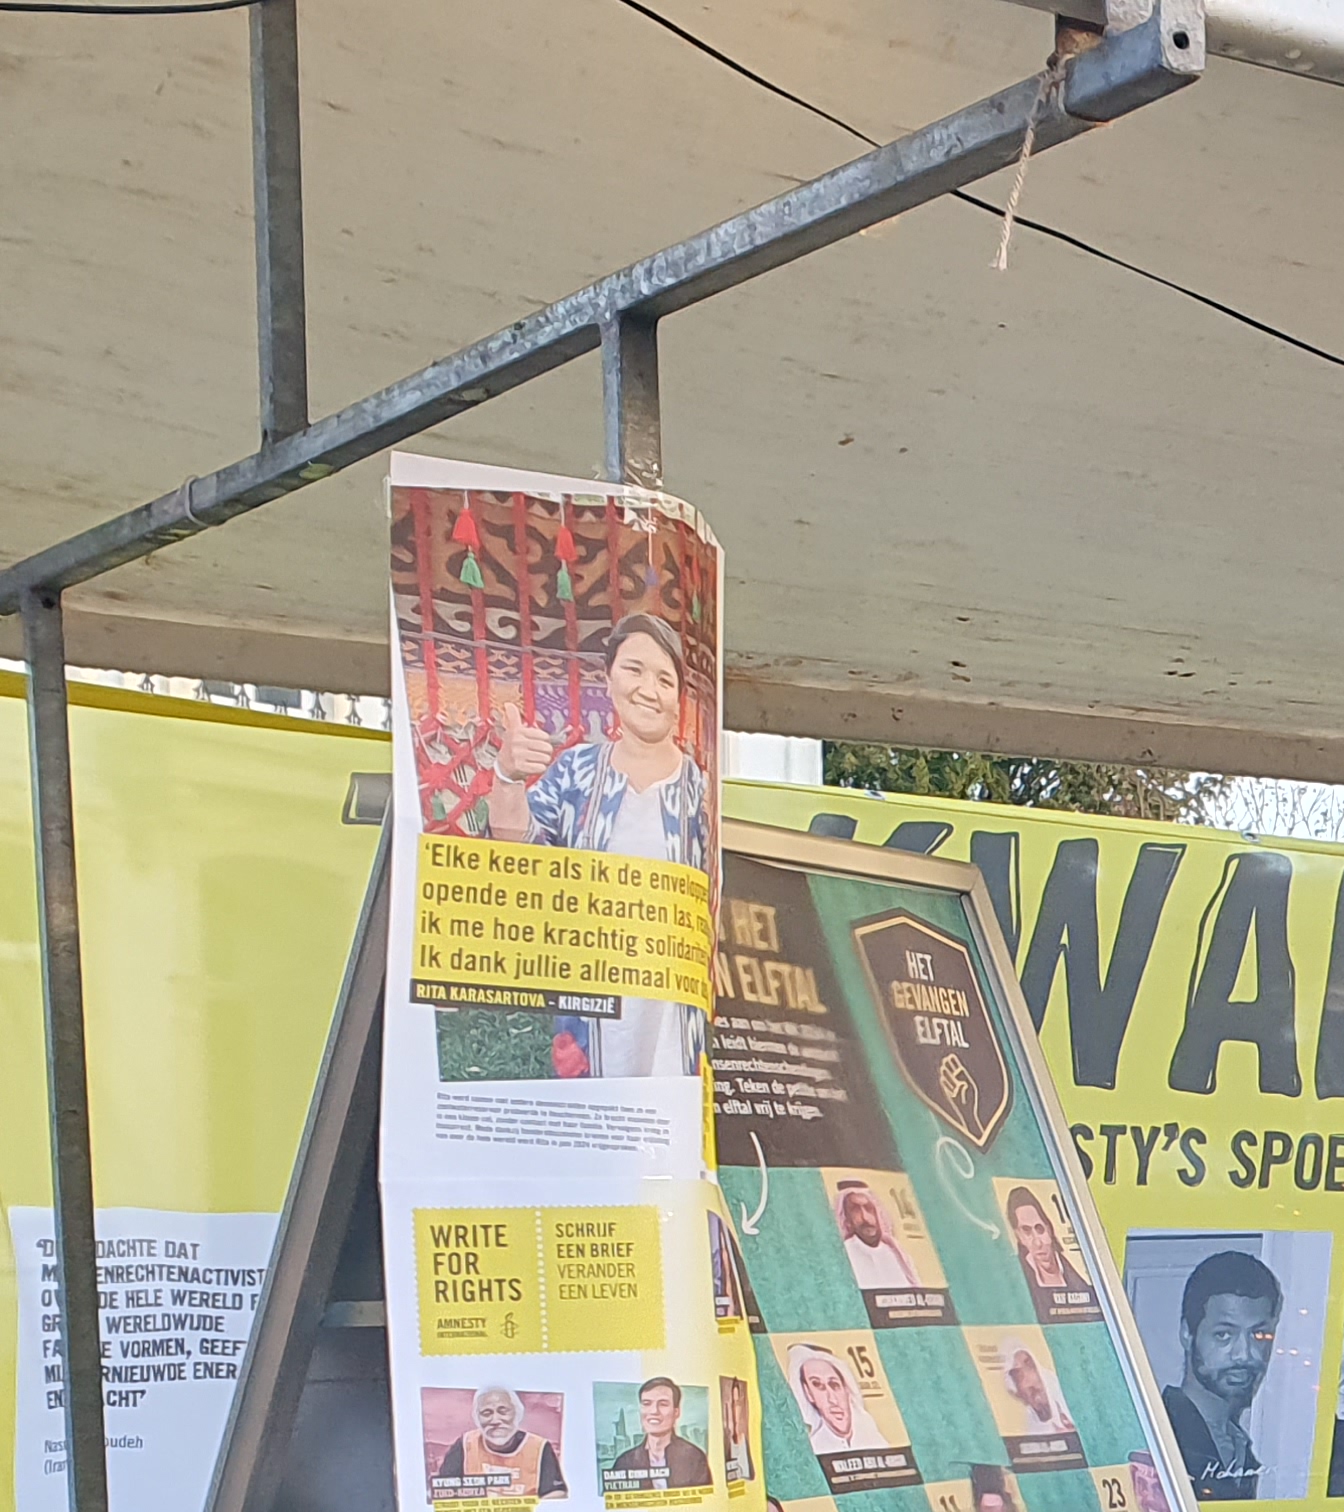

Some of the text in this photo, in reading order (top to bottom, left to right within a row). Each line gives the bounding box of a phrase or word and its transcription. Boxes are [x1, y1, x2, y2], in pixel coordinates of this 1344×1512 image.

[489, 849, 543, 876] keer
[549, 856, 581, 880] als
[590, 859, 609, 883] ik
[618, 863, 642, 886] de
[422, 881, 507, 907] opende
[516, 890, 543, 909] en
[552, 889, 578, 913] de
[587, 893, 668, 924] kaarten
[420, 911, 441, 935] ik
[450, 918, 484, 937] me
[493, 916, 534, 942] hoe
[544, 922, 638, 957] krachtig
[420, 945, 441, 968] Ik
[450, 947, 506, 974] dank
[514, 955, 571, 980] jullie
[580, 962, 670, 989] allemaal
[905, 950, 936, 982] HET
[416, 984, 447, 1000] RITA
[449, 986, 546, 1008] KARASARTOVA
[890, 981, 969, 1018] GEVANGEN
[913, 1015, 970, 1049] ELFTAL
[1072, 1122, 1207, 1187] STY'S
[430, 1224, 508, 1249] WRITE
[556, 1222, 617, 1239] SCHRIJF
[164, 1240, 200, 1261] DAT
[556, 1243, 634, 1259] EEN BRIEF
[433, 1252, 480, 1276] FOR
[557, 1263, 636, 1279] VERANDER
[125, 1289, 163, 1309] HELE
[171, 1289, 243, 1311] WERELD
[435, 1279, 522, 1303] RIGHTS
[559, 1283, 638, 1300] EEN LEVEN
[437, 1318, 486, 1330] AMNESTY
[120, 1338, 192, 1359] VORMEN,
[847, 1345, 875, 1379] 15
[1102, 1478, 1127, 1509] 23
